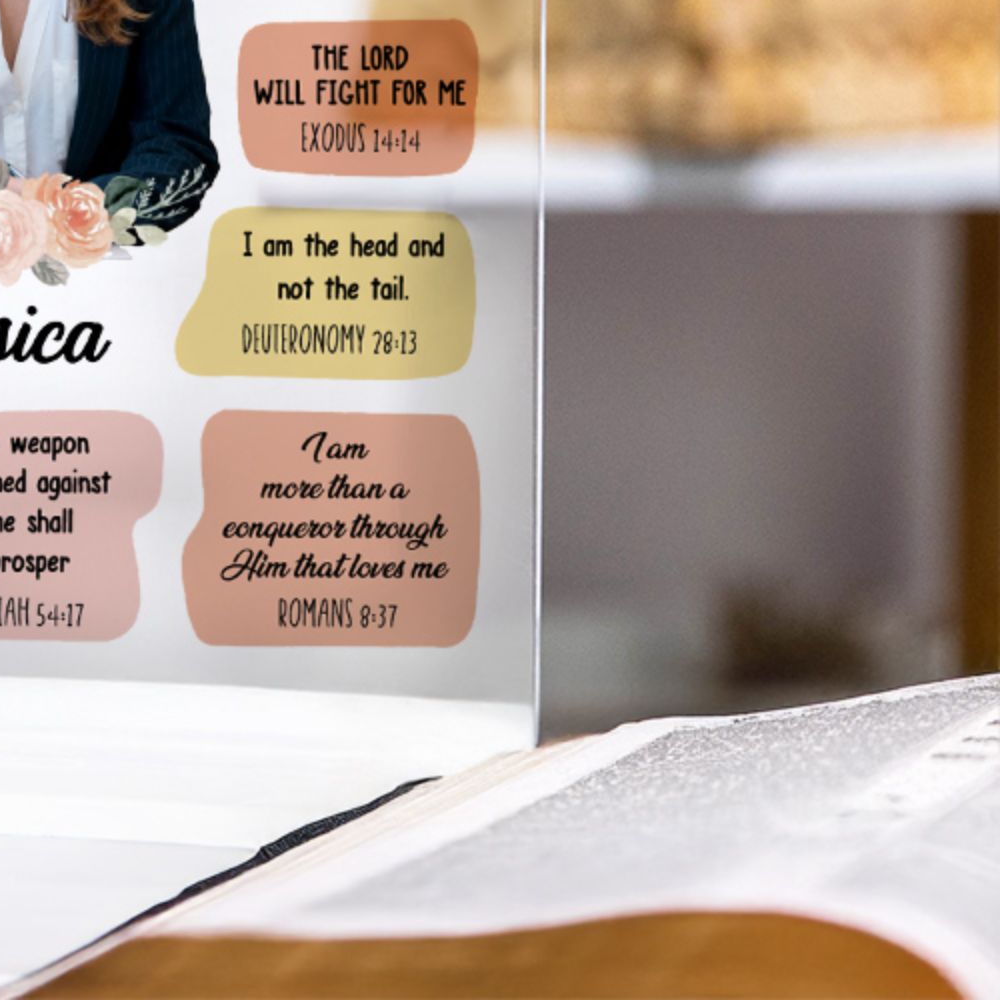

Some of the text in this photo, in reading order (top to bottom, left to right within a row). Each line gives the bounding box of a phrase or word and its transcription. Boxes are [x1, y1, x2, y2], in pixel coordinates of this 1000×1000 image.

[311, 44, 409, 72] THE LORD
[253, 79, 467, 107] WILL FIGHT FOR ME
[301, 121, 420, 153] EXODUS 14:14
[243, 231, 445, 258] I am the head and
[277, 275, 409, 301] not the tail.
[243, 323, 417, 355] DEUTERONOMY 28:13
[10, 436, 90, 461] weapon
[301, 431, 370, 464] I am
[36, 471, 112, 501] against
[260, 473, 411, 500] more than a
[27, 507, 74, 534] shall
[349, 513, 449, 551] through
[219, 548, 450, 582] Him that loves me
[37, 603, 84, 627] 54:17
[278, 597, 398, 629] ROMANS 8:37
